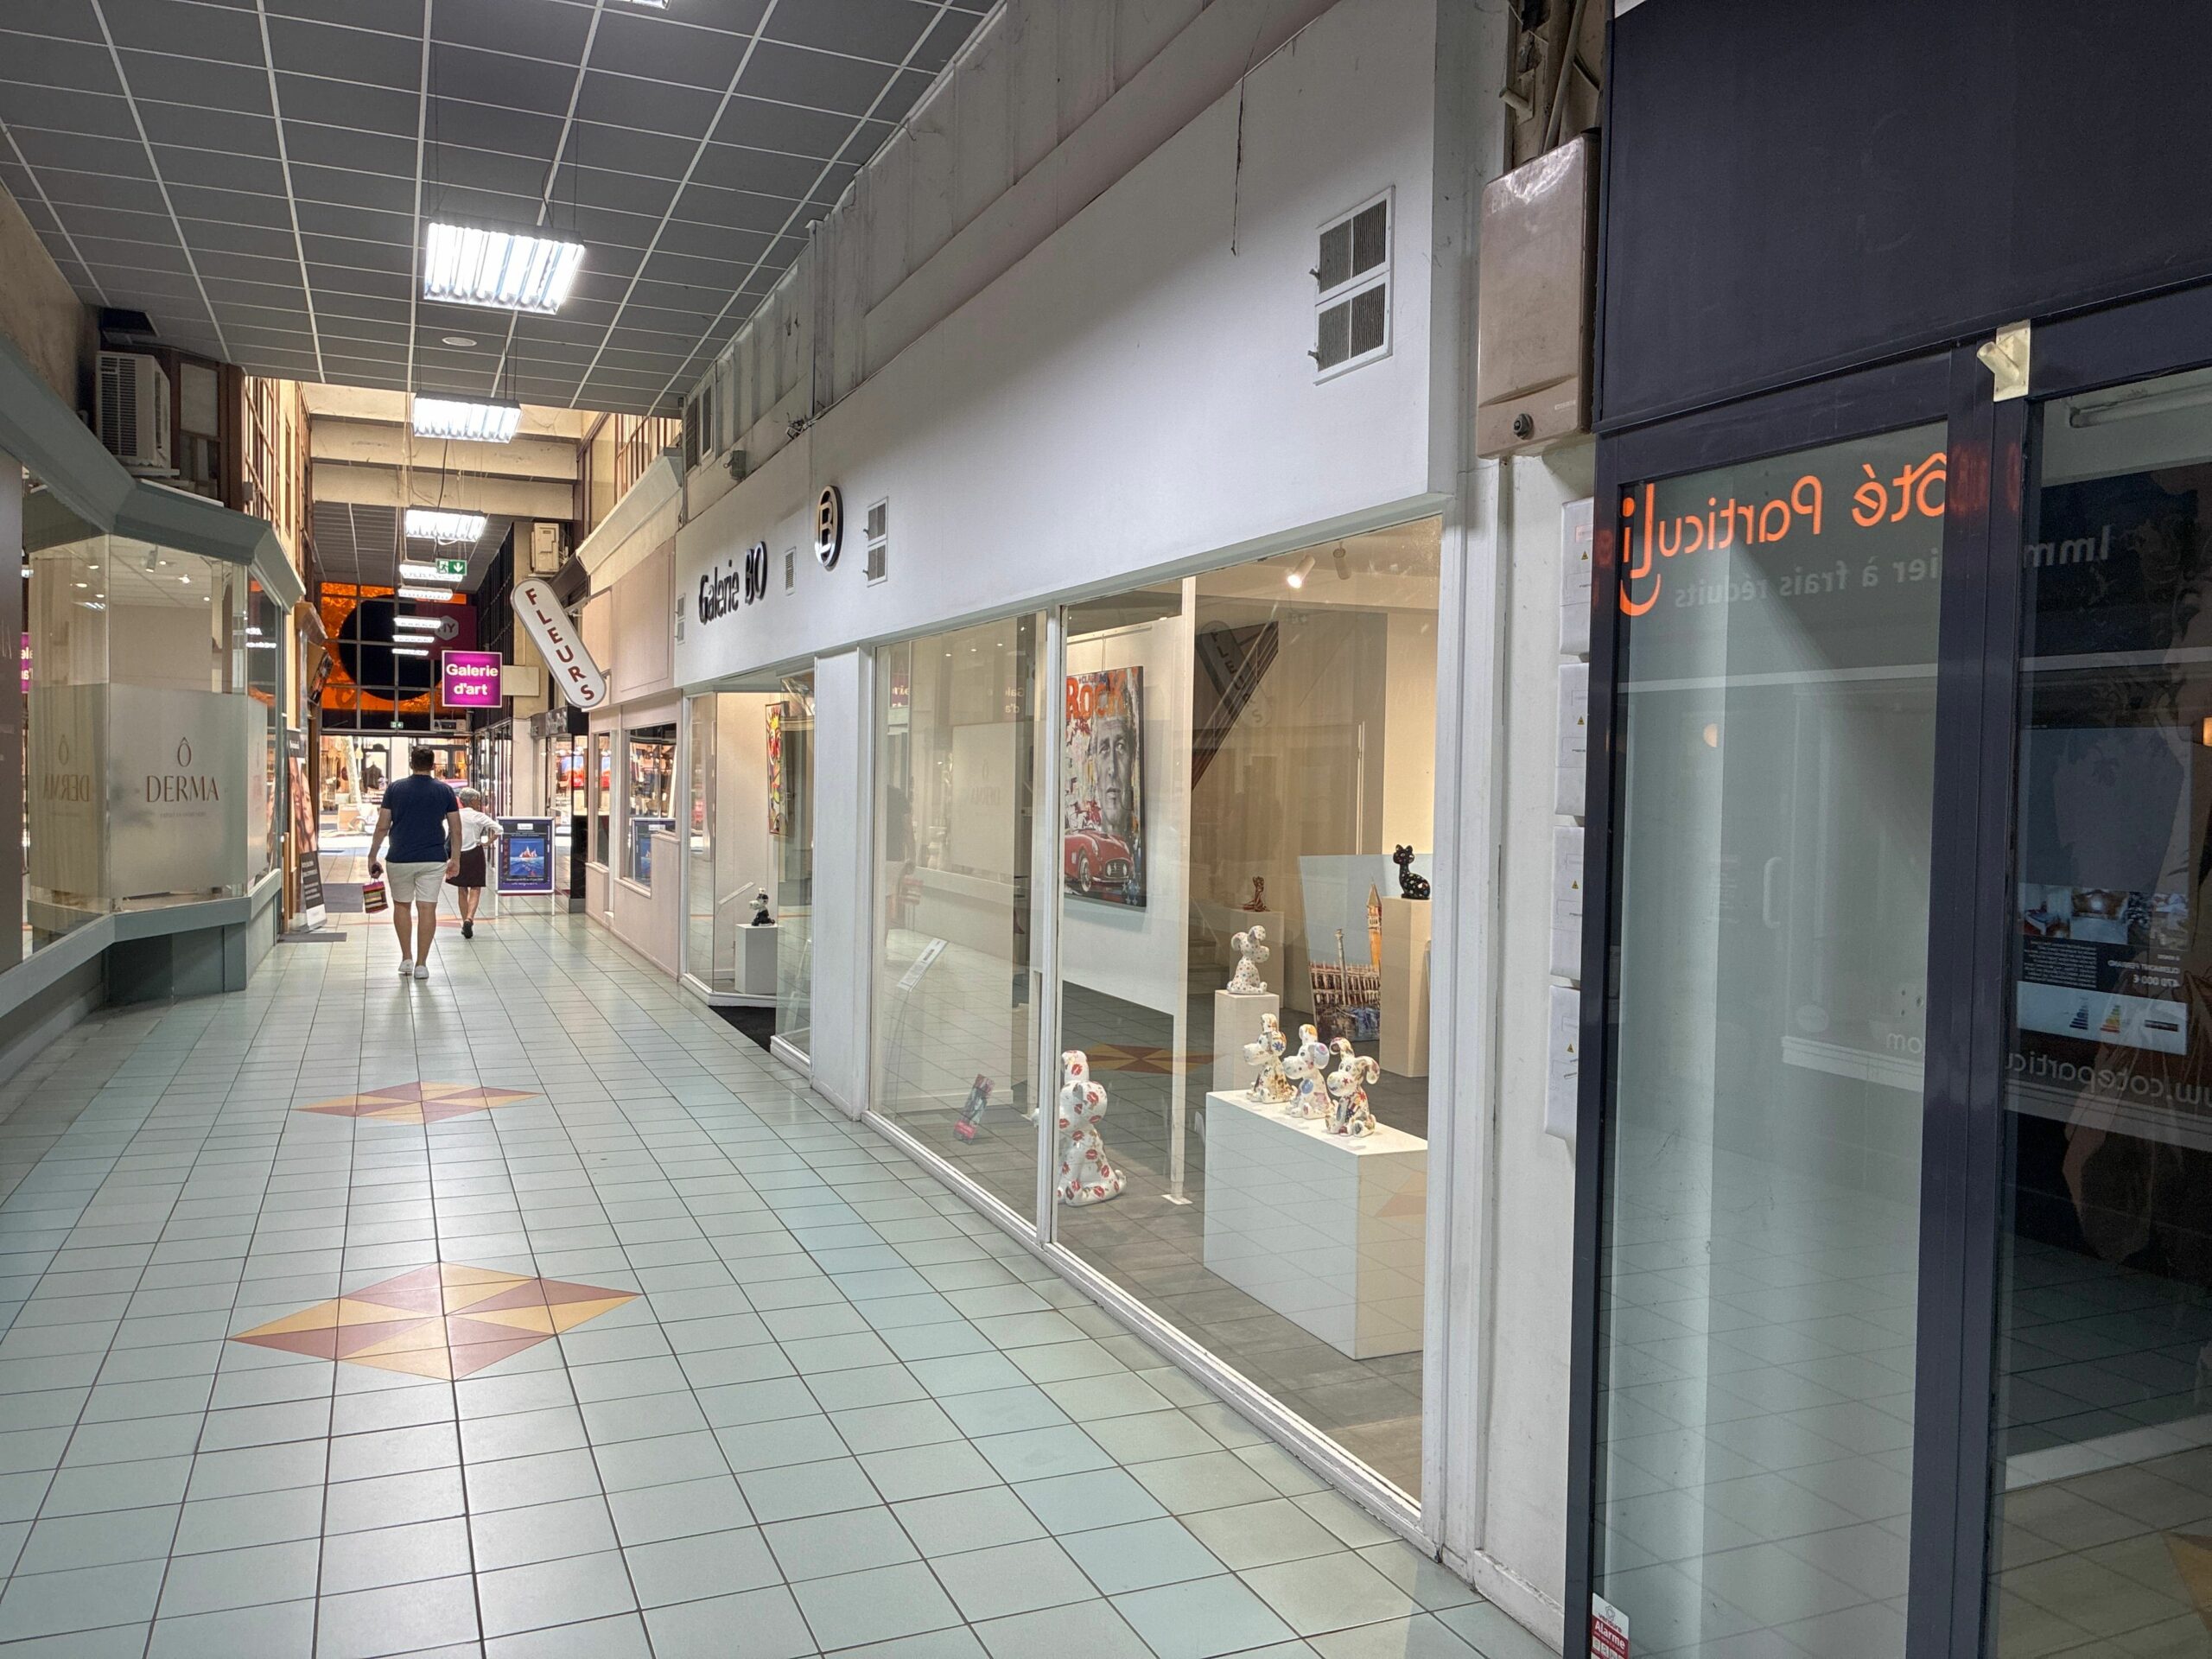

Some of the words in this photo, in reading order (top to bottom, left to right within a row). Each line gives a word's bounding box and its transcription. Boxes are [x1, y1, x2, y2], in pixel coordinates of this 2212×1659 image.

[698, 559, 740, 626] Galerie
[745, 540, 768, 606] BO
[524, 588, 595, 701] FLEURS
[446, 663, 499, 677] Galerie
[454, 682, 488, 696] d'art
[177, 736, 192, 768] Ô
[146, 775, 219, 803] DERMA
[1594, 1620, 1626, 1650] Alarme
